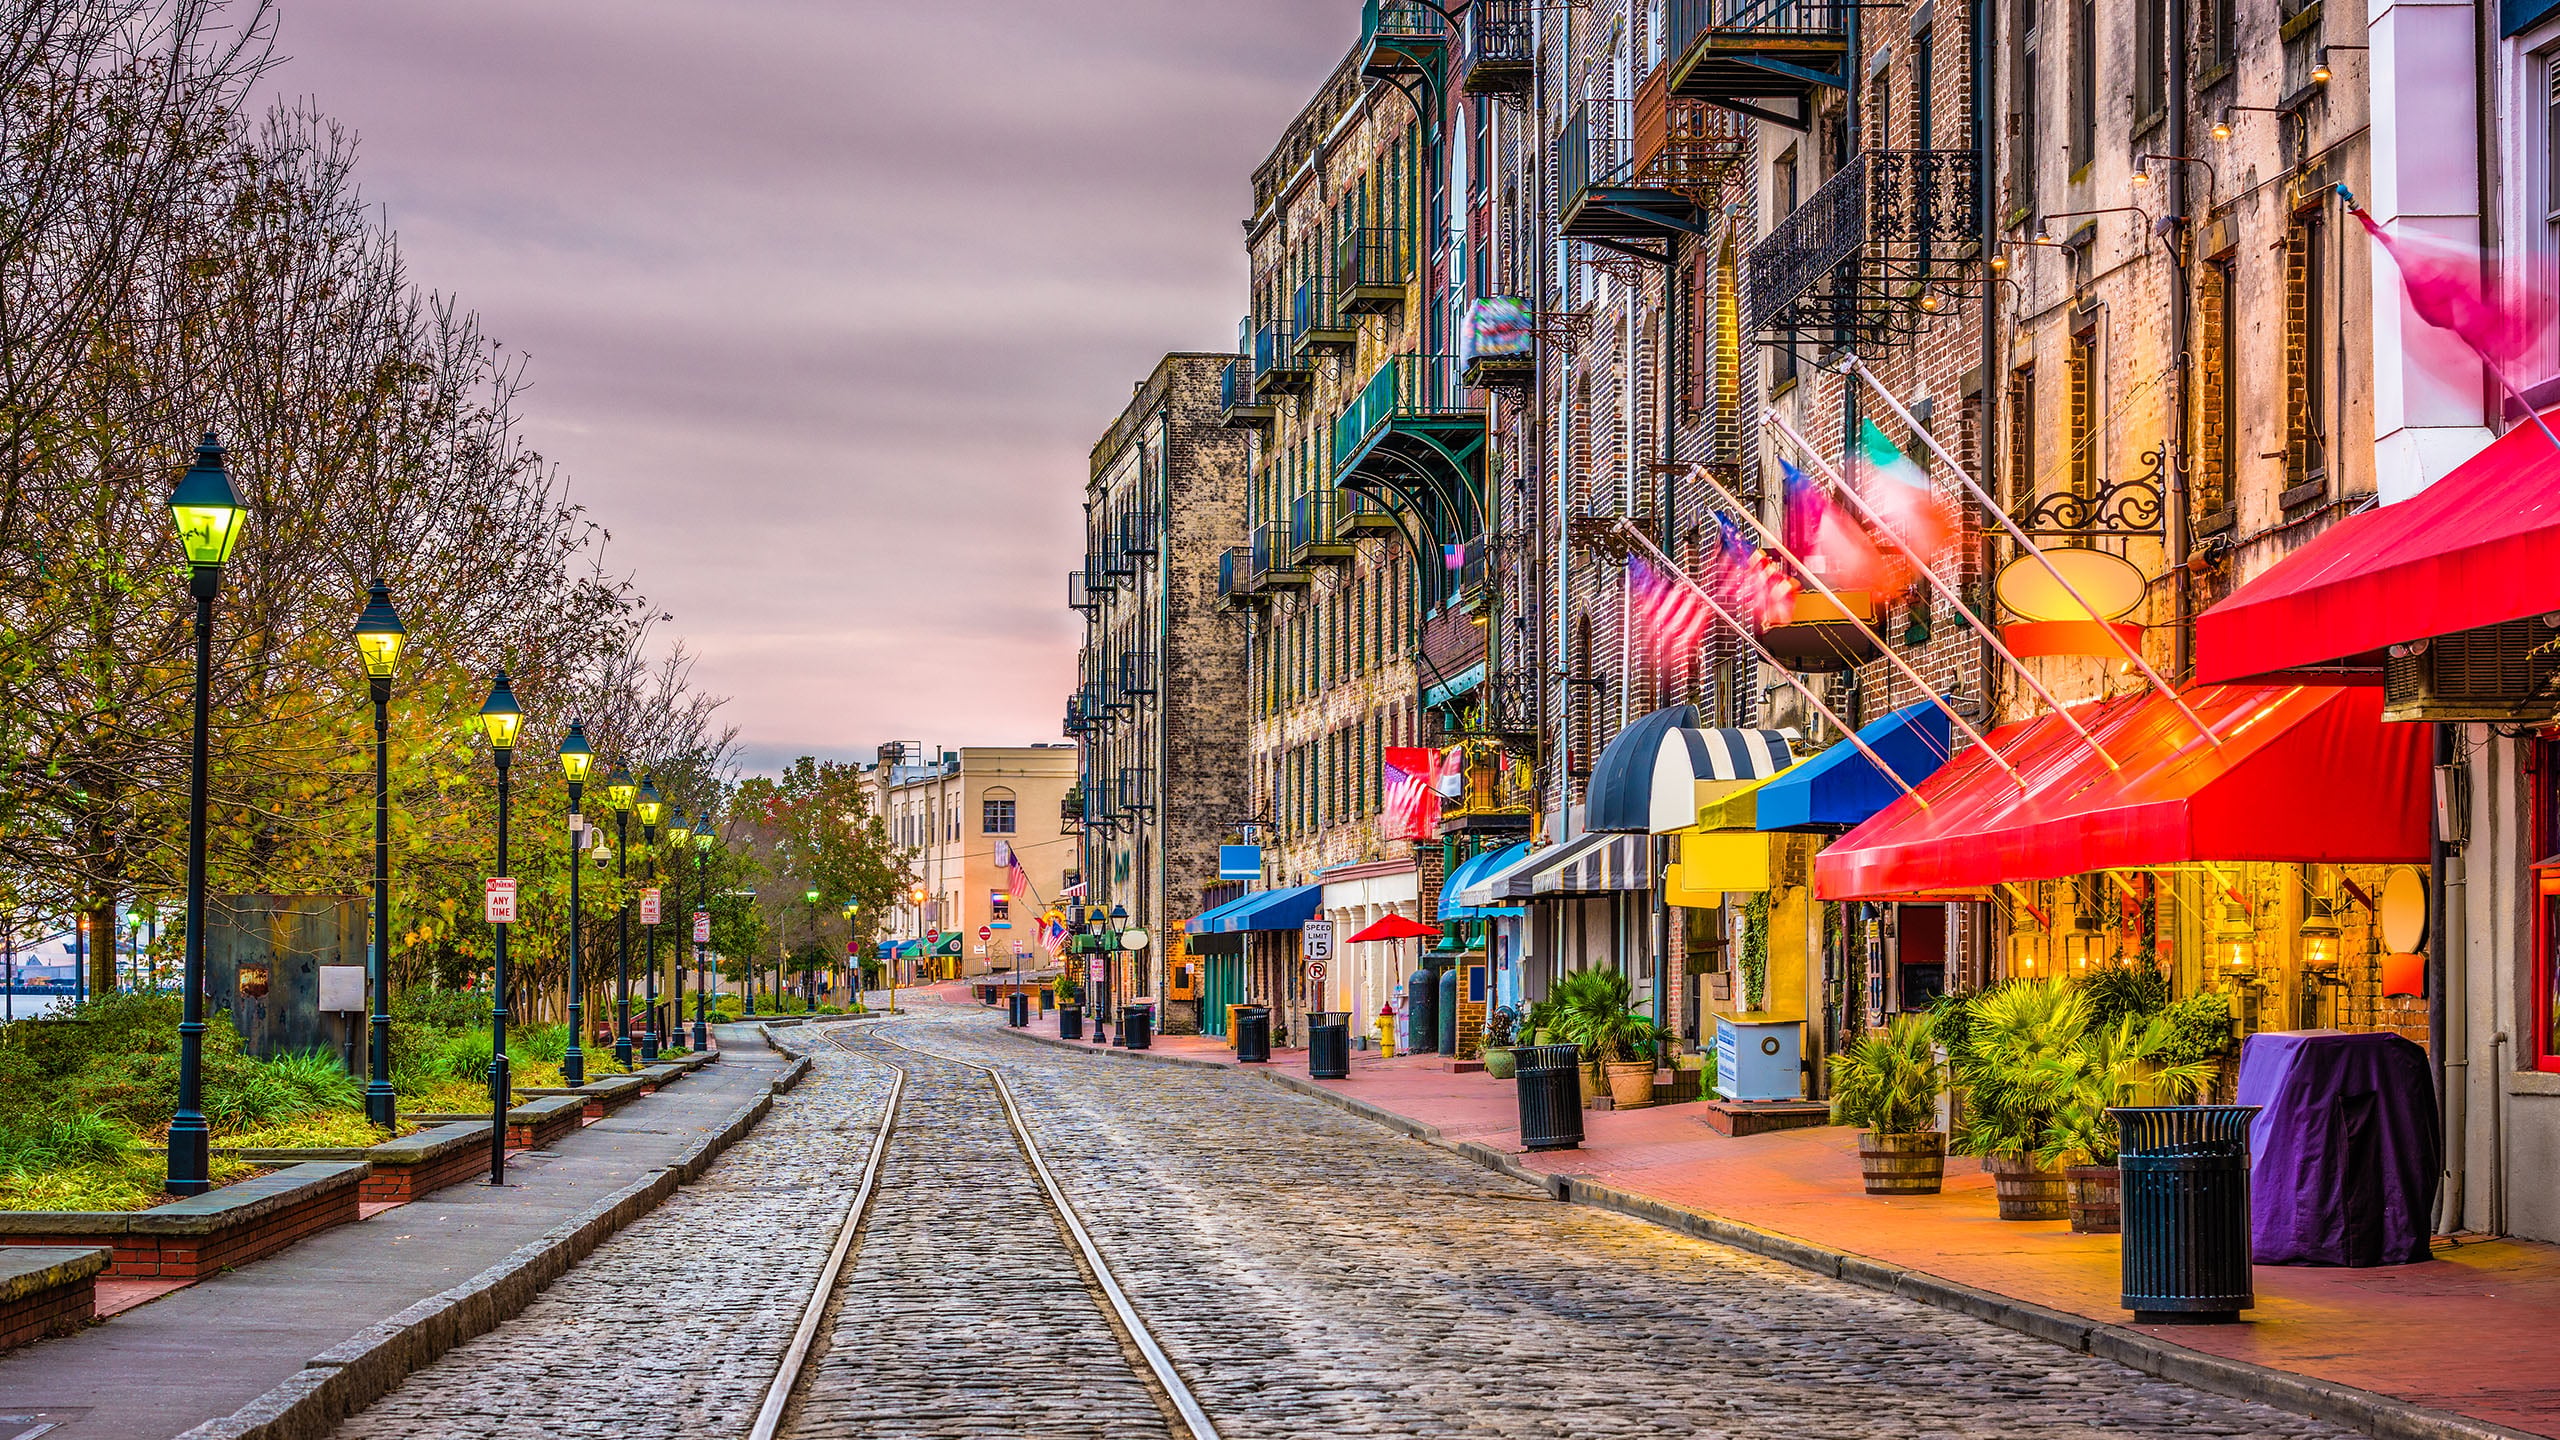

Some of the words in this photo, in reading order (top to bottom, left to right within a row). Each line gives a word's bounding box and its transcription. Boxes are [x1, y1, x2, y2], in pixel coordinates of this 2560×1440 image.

[487, 881, 496, 890] NO
[491, 908, 510, 916] TIME
[1308, 942, 1327, 956] 15
